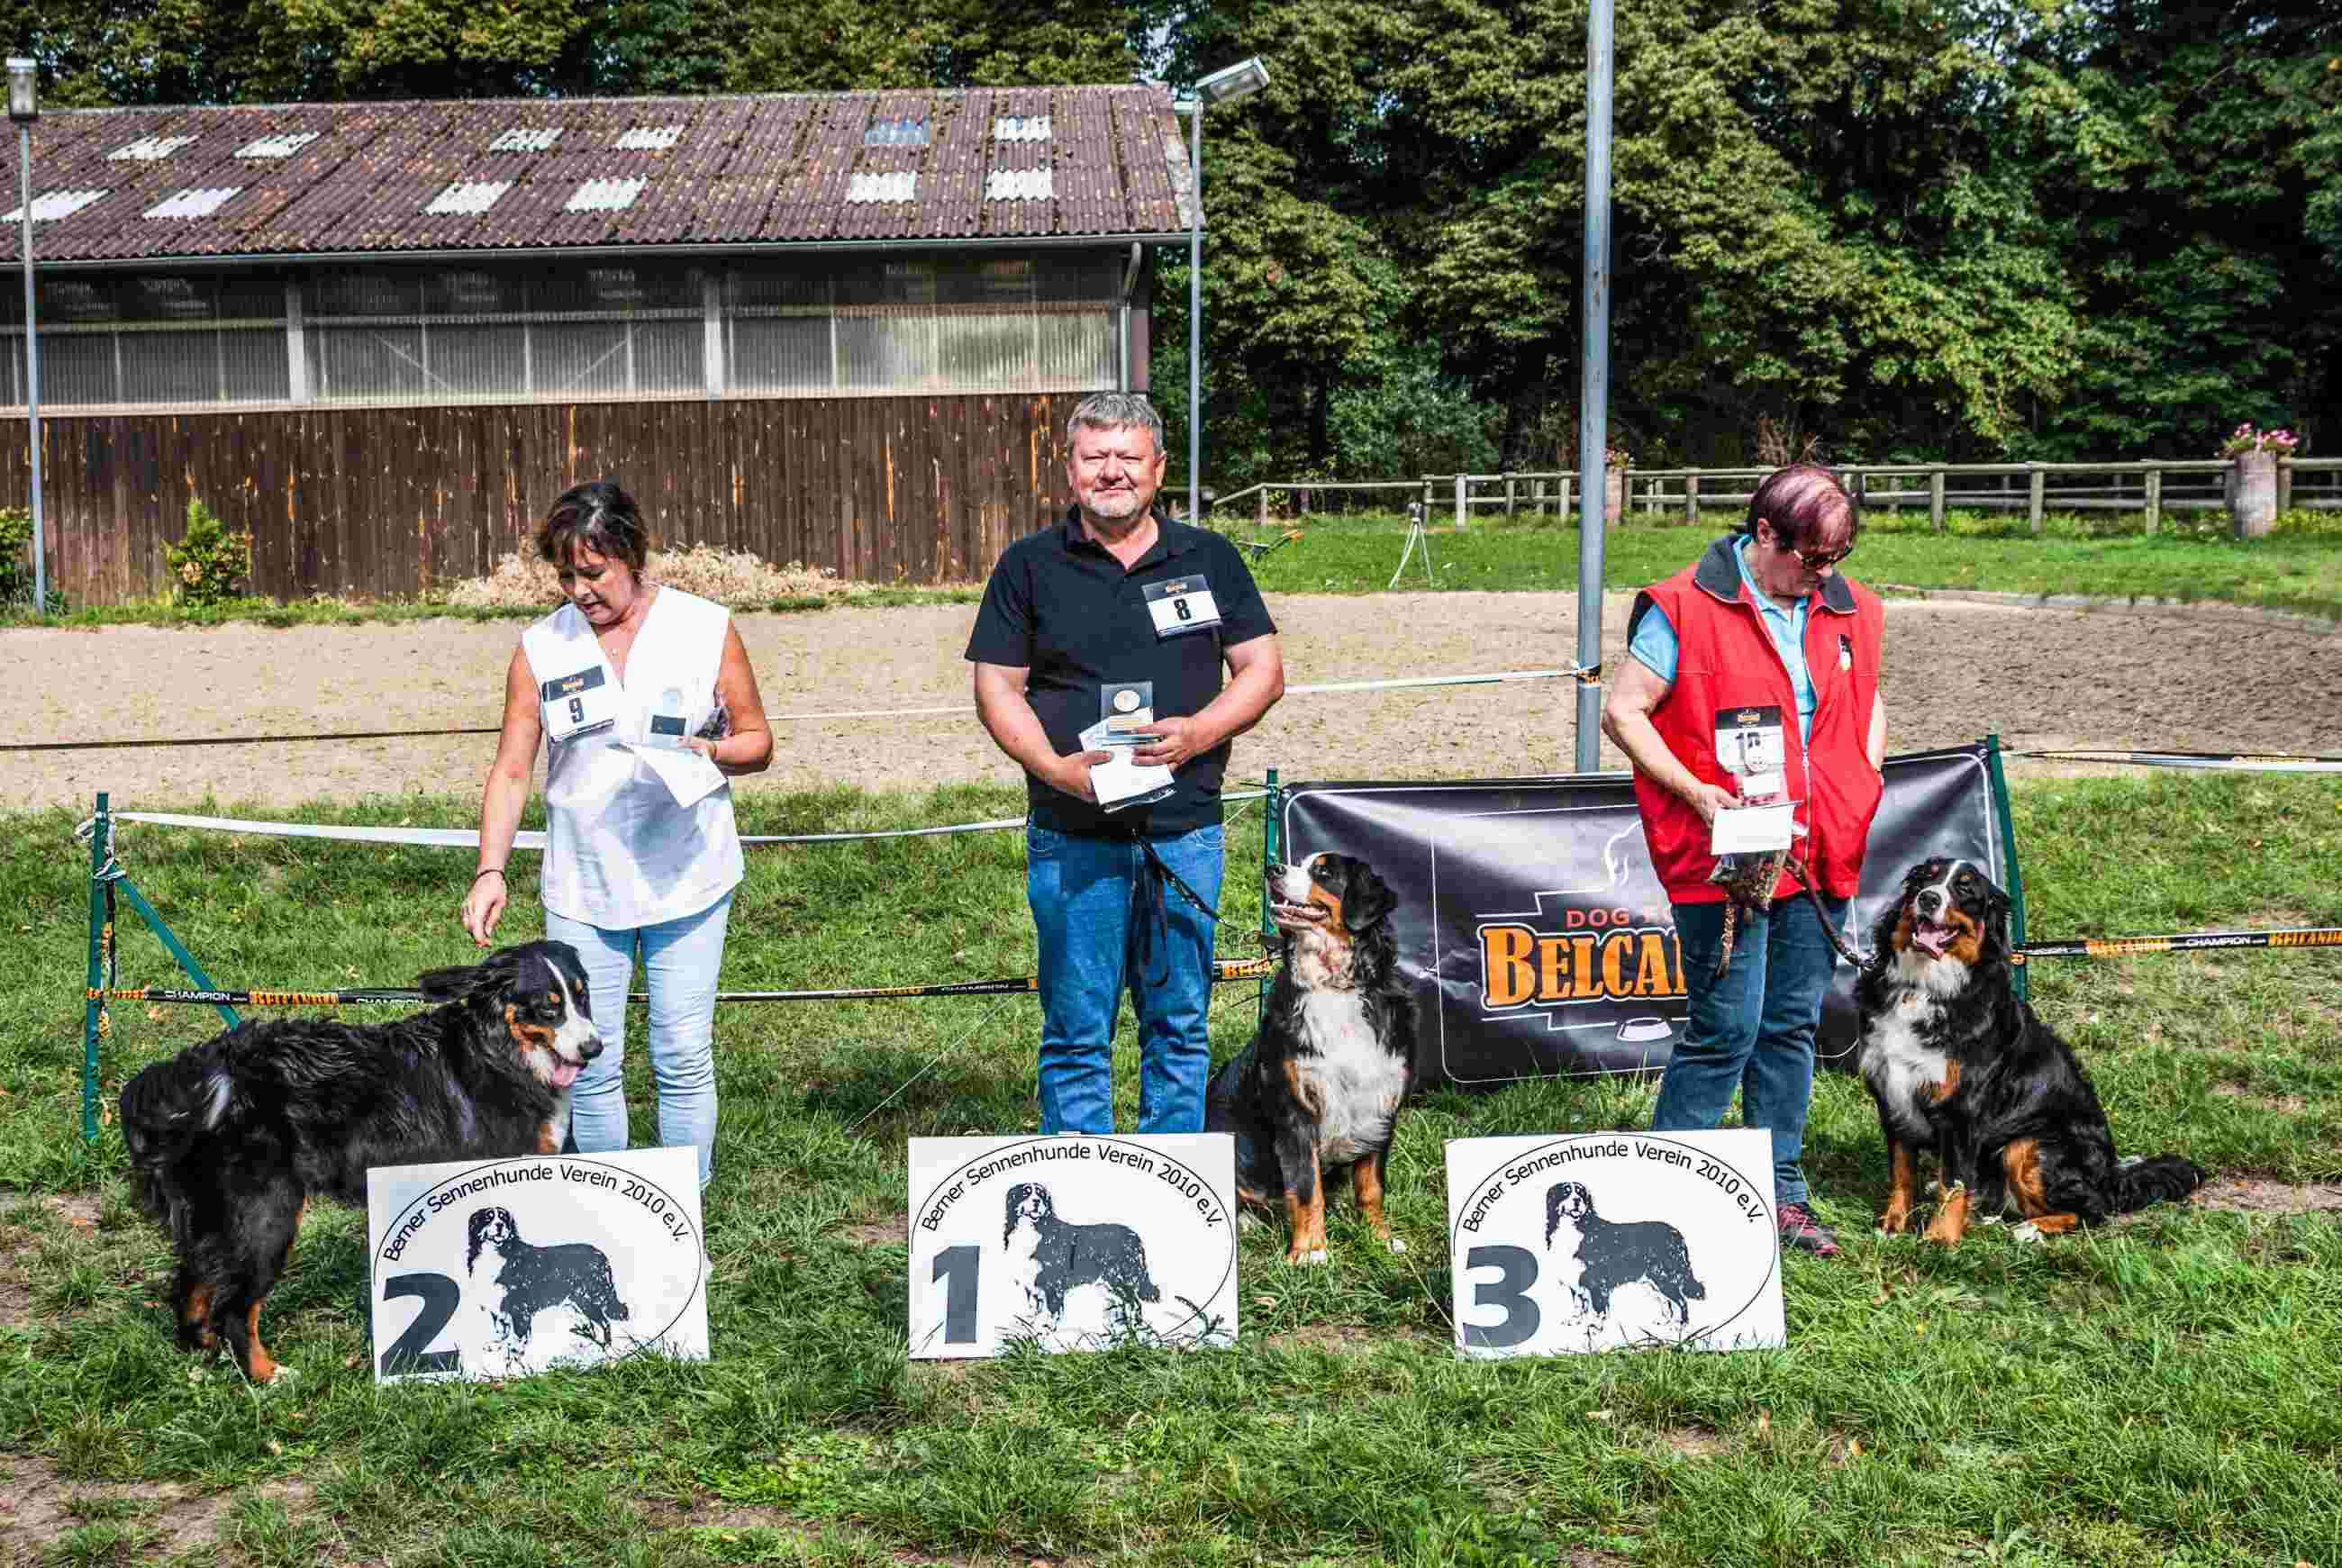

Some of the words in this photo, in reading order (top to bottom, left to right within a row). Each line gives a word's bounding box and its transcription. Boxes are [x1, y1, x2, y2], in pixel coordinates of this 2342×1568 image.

[1174, 598, 1191, 620] 8
[569, 697, 584, 724] 9
[1566, 908, 1629, 929] DOG
[2185, 936, 2250, 947] CHAMPION
[164, 990, 231, 1002] CHAMPION
[384, 1210, 426, 1262] Berner
[427, 1165, 553, 1215] Sennenhunde
[559, 1165, 617, 1191] Verein
[622, 1180, 666, 1214] 2010
[662, 1210, 689, 1242] e.V.
[921, 1180, 965, 1231] Berner
[967, 1143, 1091, 1186] Sennenhunde
[1098, 1144, 1154, 1173] Verein
[1157, 1163, 1202, 1199] 2010
[1197, 1196, 1223, 1228] e.V.
[1463, 1179, 1506, 1233] Berner
[1505, 1140, 1629, 1186] Sennenhunde
[1635, 1141, 1692, 1170] Verein
[1696, 1159, 1740, 1194] 2010
[1737, 1193, 1764, 1223] e.V.
[380, 1273, 460, 1377] 2
[932, 1245, 981, 1344] 1
[1463, 1245, 1541, 1348] 3
